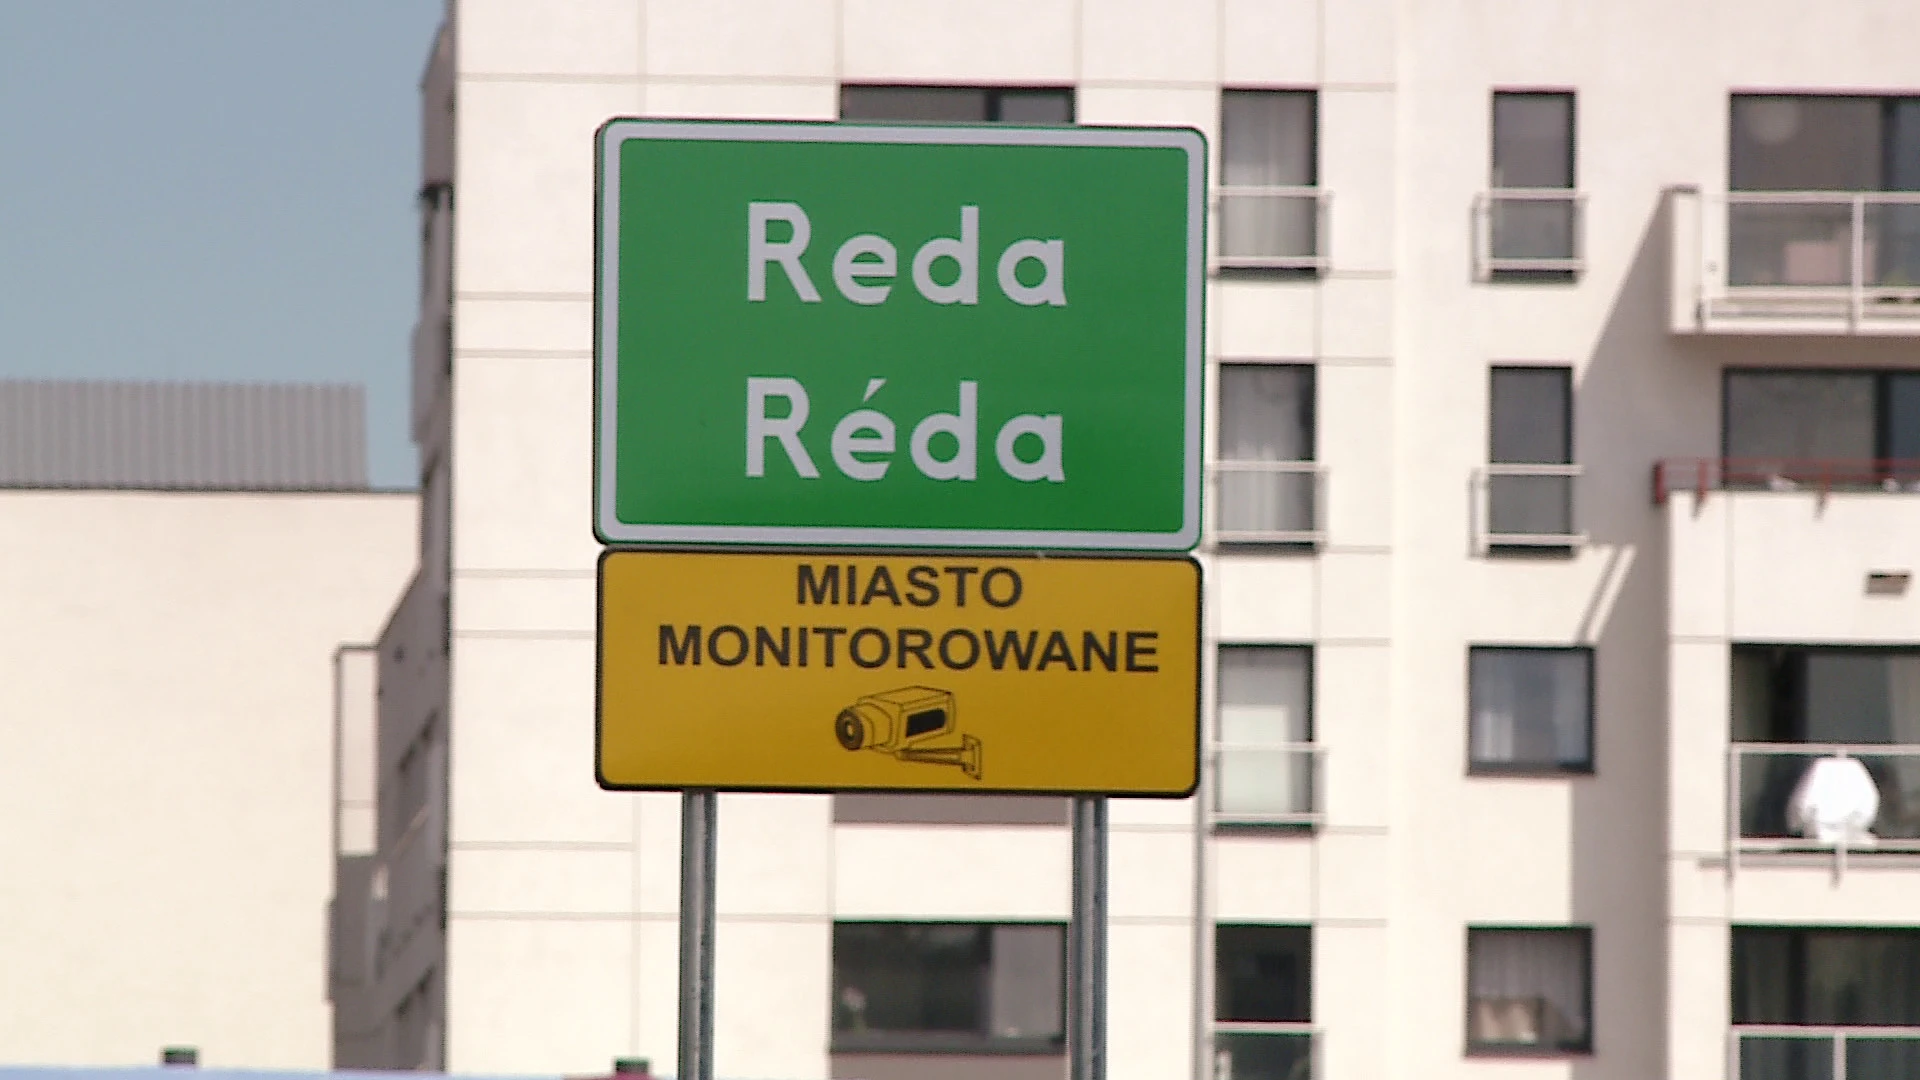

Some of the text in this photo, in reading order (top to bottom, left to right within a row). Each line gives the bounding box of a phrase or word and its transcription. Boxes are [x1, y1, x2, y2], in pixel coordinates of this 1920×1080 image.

[747, 201, 1067, 306] Reda
[746, 377, 1065, 481] Réda
[797, 564, 1023, 608] MIASTO
[658, 624, 1160, 673] MONITOROWANE
